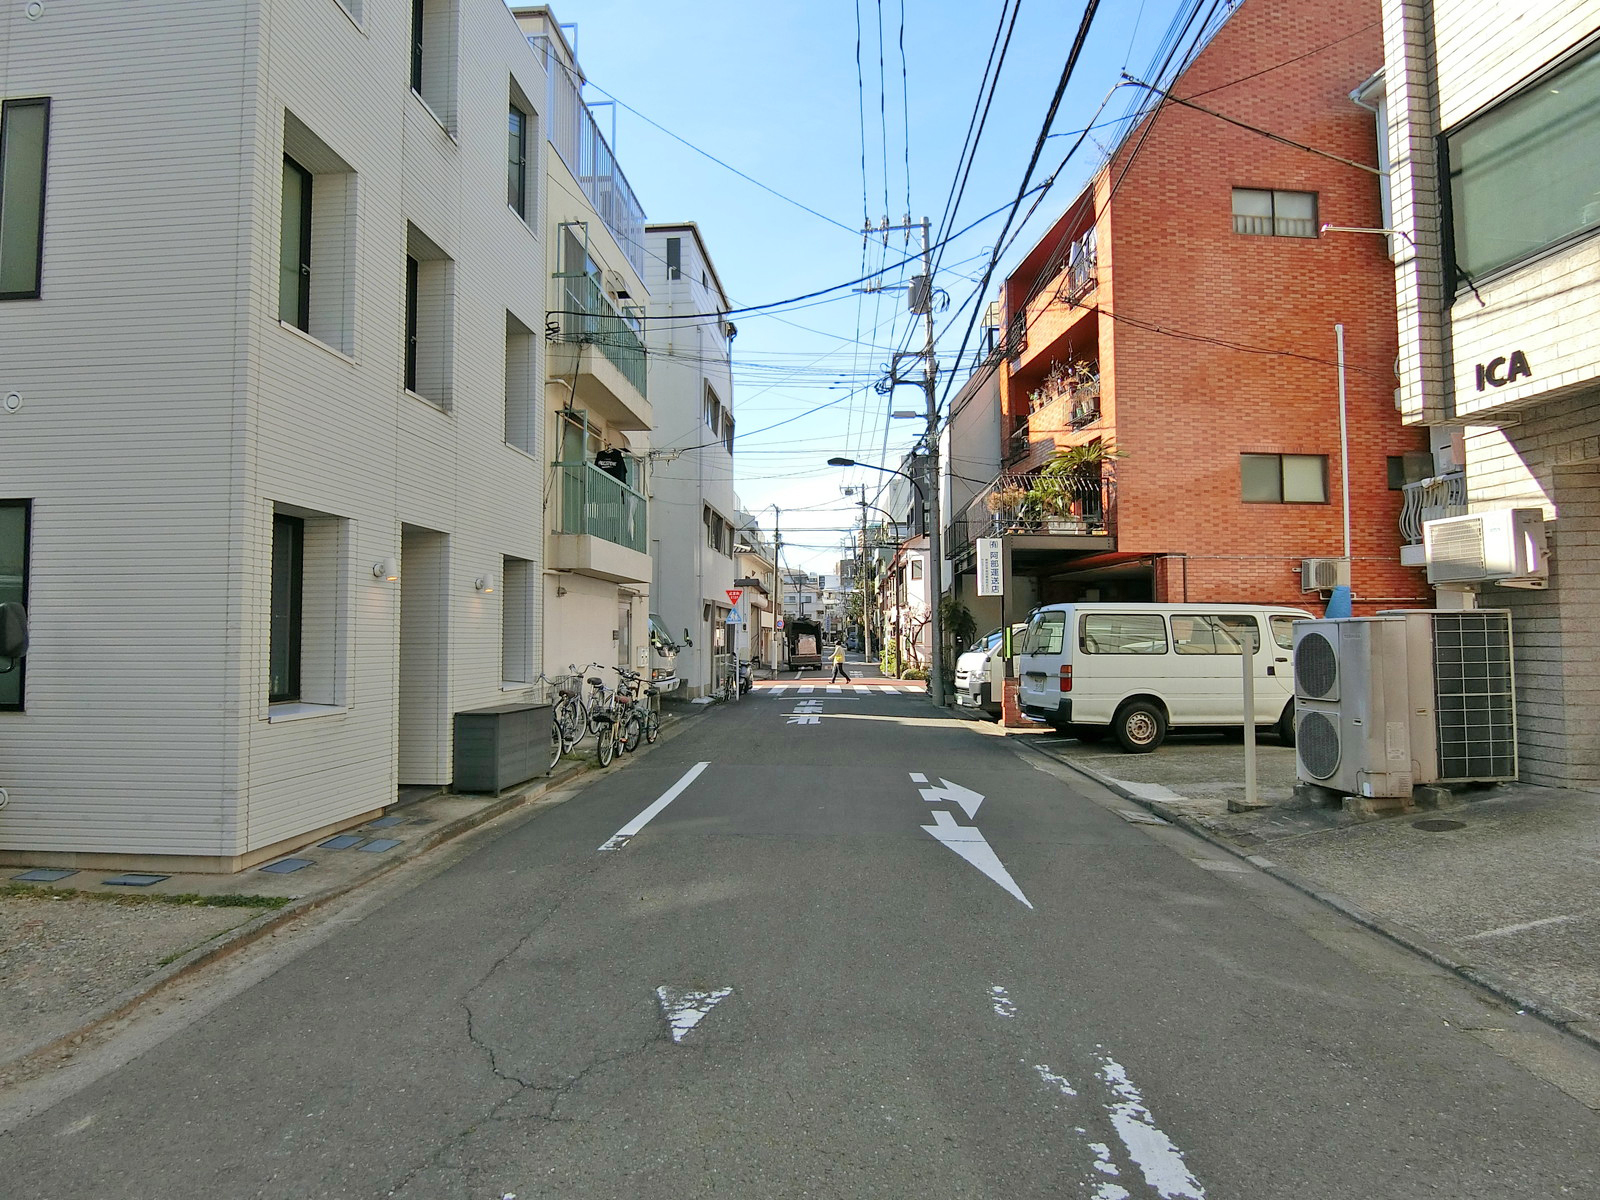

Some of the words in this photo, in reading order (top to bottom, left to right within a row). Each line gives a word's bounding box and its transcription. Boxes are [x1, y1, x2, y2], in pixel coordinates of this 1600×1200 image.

[1475, 350, 1532, 392] ICA
[990, 551, 1000, 594] 阿部運送店
